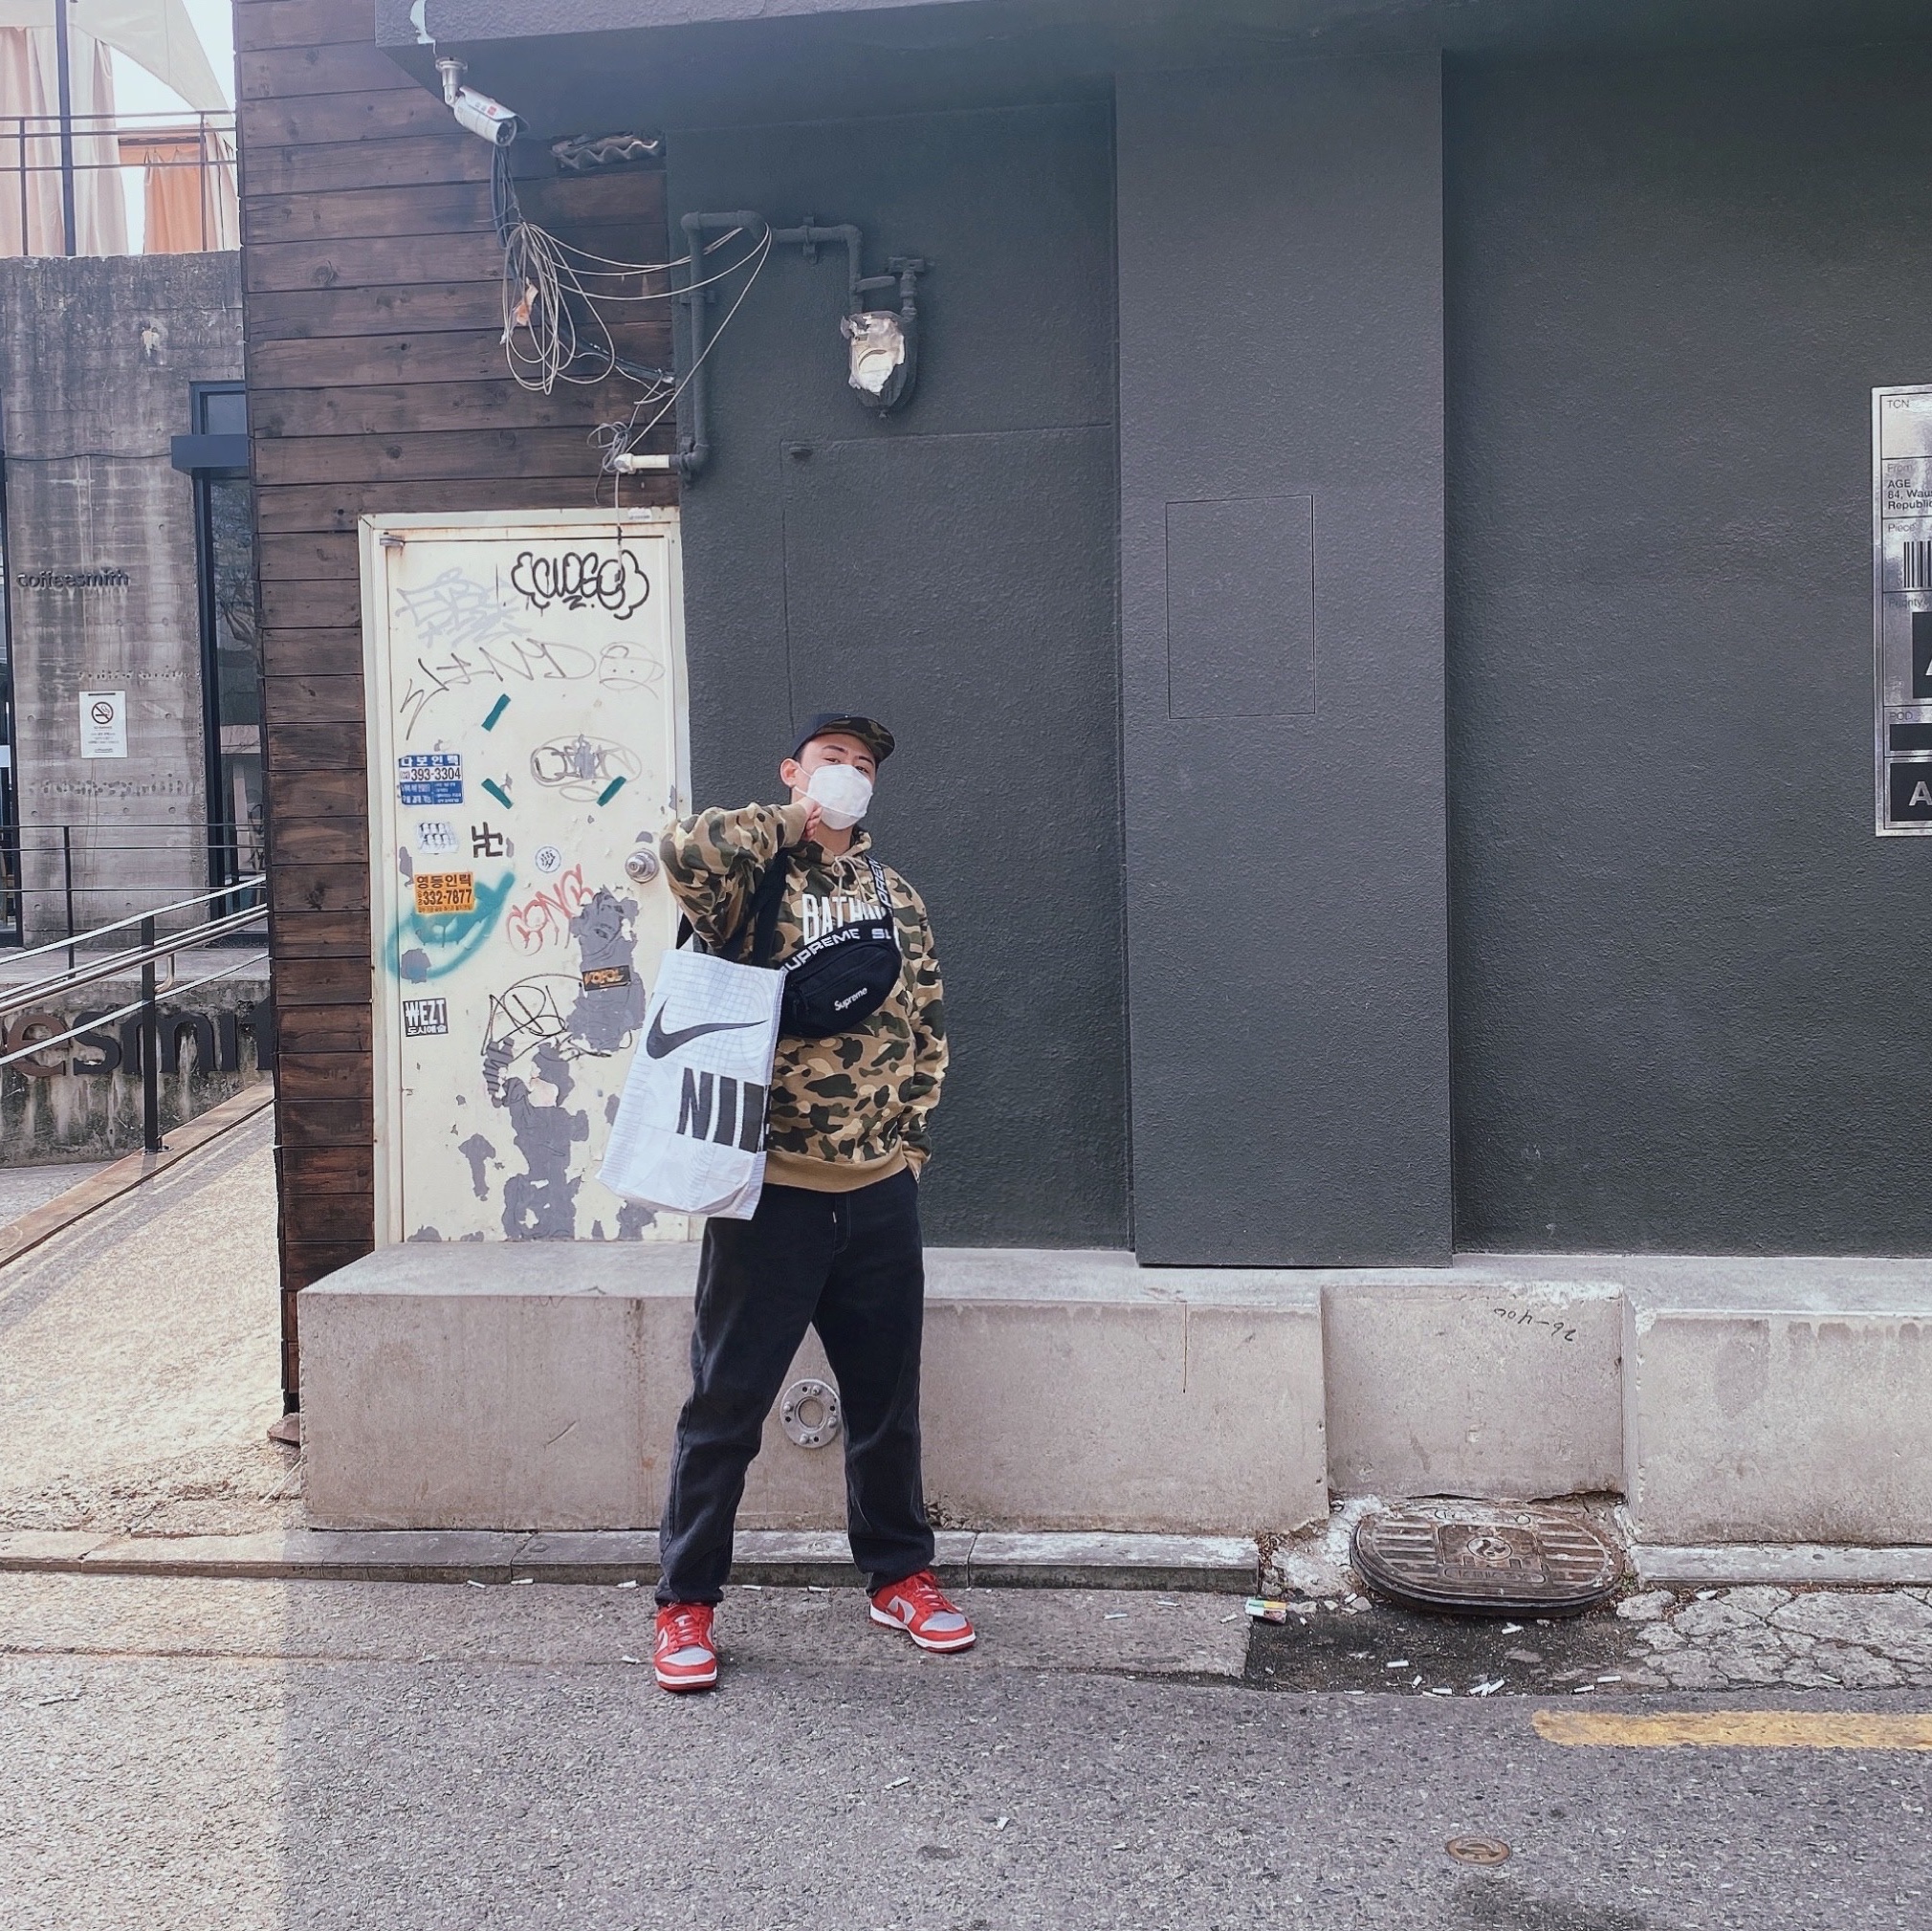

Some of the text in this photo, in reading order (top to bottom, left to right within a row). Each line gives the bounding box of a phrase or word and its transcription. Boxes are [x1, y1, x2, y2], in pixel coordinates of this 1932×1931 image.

[1887, 399, 1910, 409] TCN
[1887, 463, 1913, 473] From
[1887, 479, 1911, 489] AGE
[16, 570, 129, 588] coffeesmith
[411, 767, 461, 781] 393-3304
[423, 889, 472, 906] 332-7877
[834, 987, 867, 1011] Supreme
